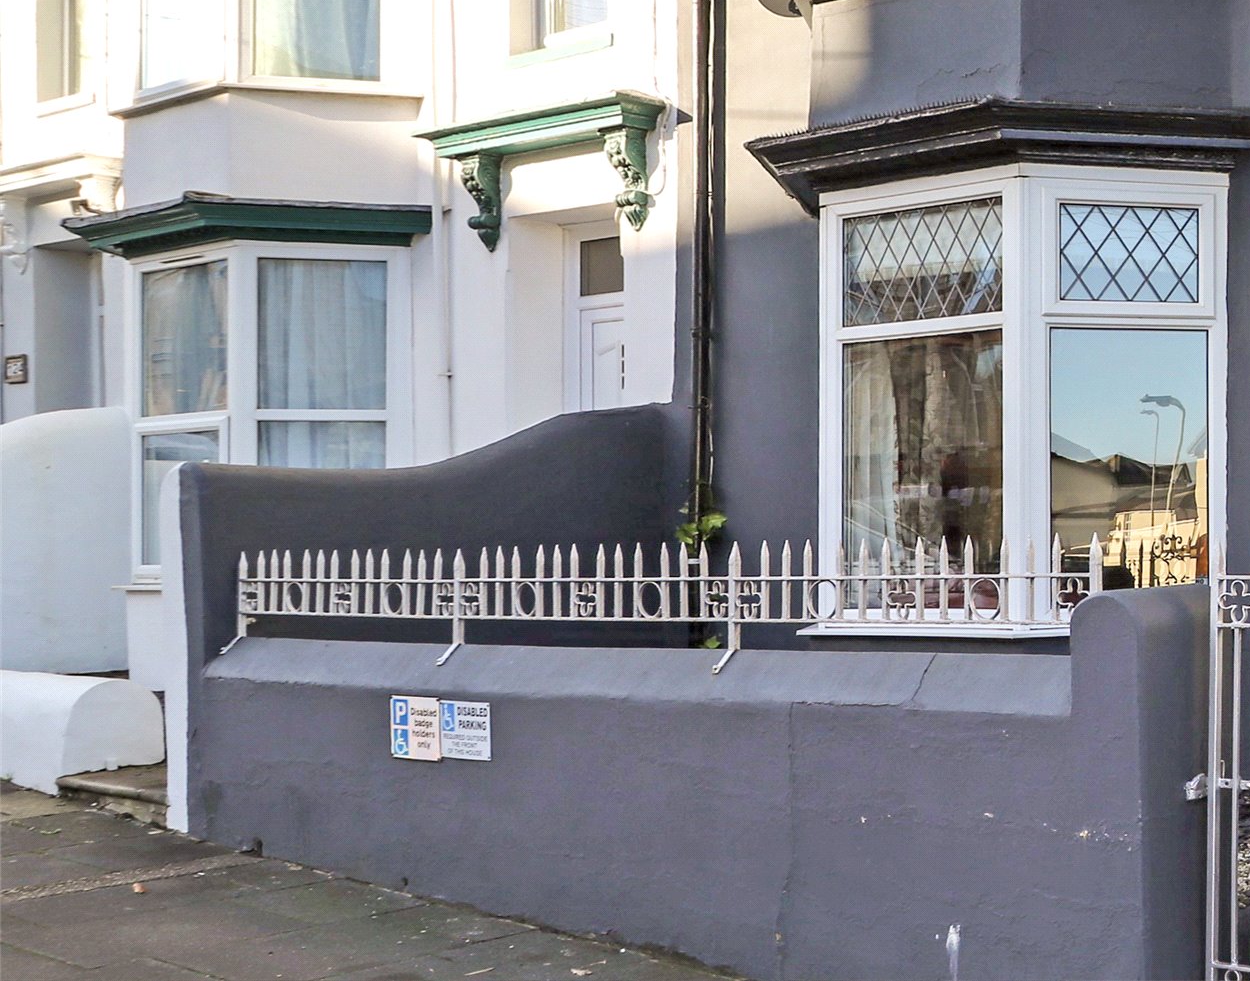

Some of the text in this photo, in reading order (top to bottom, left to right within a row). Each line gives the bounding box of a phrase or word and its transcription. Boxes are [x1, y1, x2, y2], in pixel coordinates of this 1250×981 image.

[395, 701, 407, 724] P
[410, 707, 437, 717] Disabled
[457, 706, 488, 717] DISABLED
[414, 719, 433, 729] badge
[458, 719, 487, 731] PARKING
[412, 730, 436, 738] holders
[417, 741, 431, 750] only
